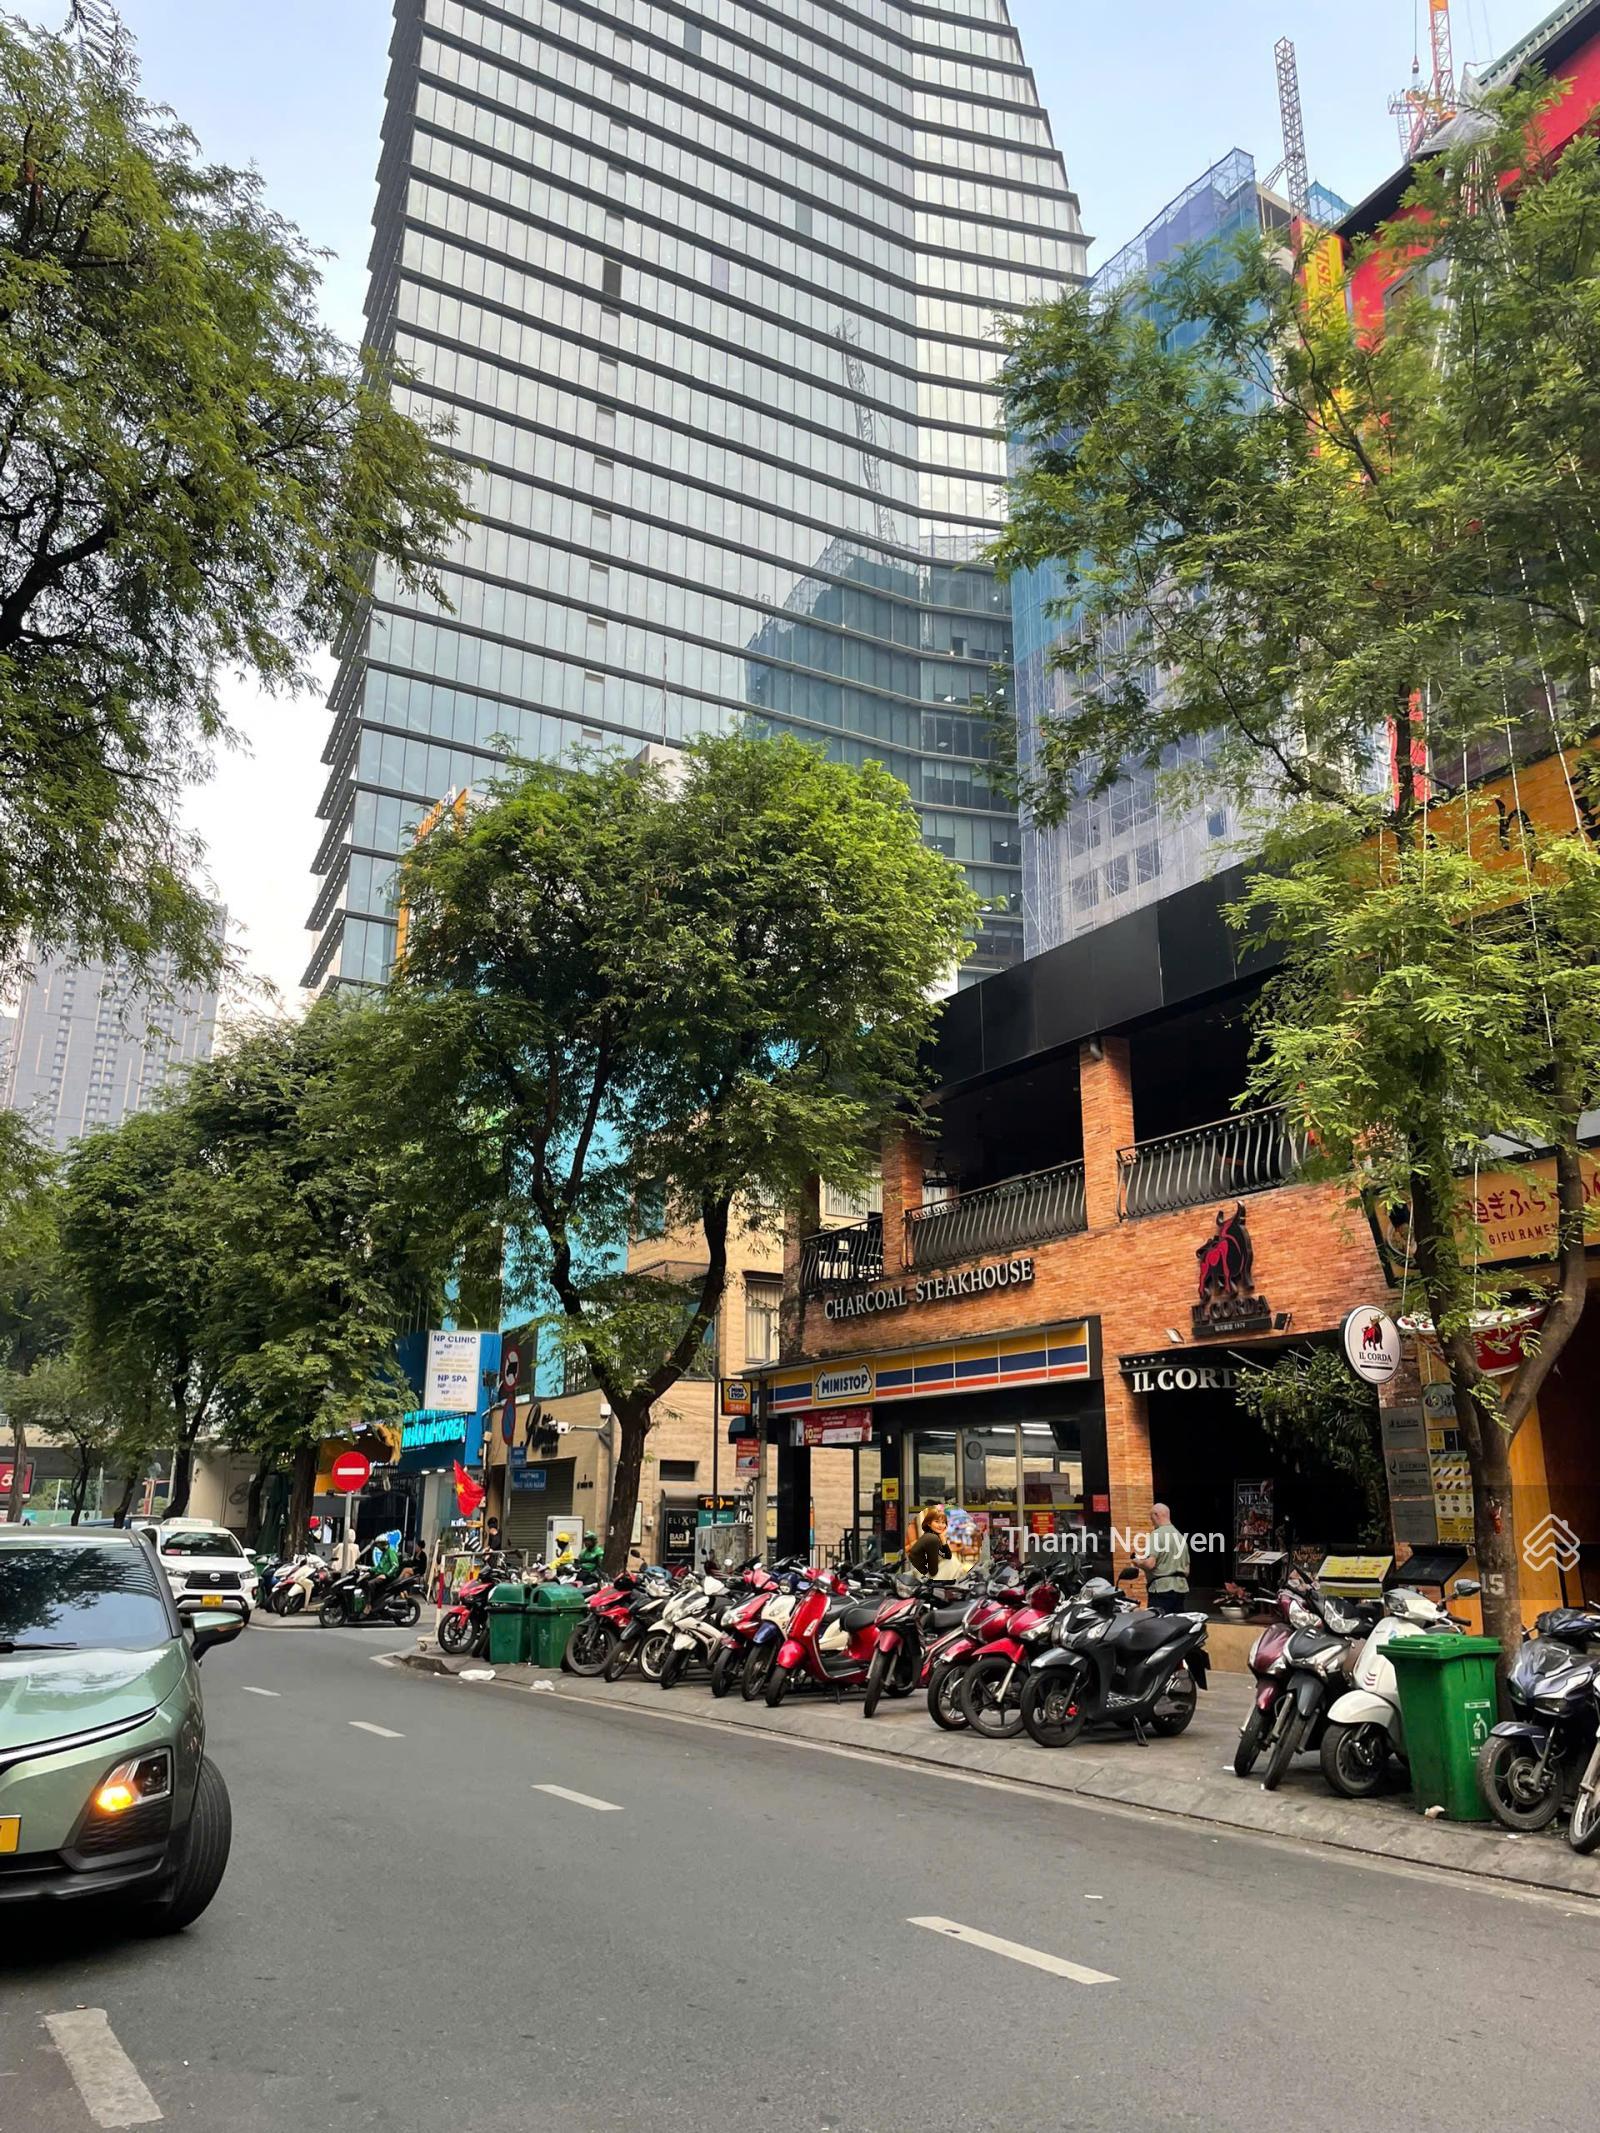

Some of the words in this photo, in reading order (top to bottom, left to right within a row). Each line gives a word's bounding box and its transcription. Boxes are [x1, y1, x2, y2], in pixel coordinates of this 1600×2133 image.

[1488, 1231, 1515, 1245] GIFU
[1519, 1222, 1558, 1239] RAMEN
[824, 1287, 908, 1320] CHARCOAL
[915, 1259, 1034, 1303] STEAKHOUSE
[447, 1336, 477, 1344] CLINIC
[1359, 1352, 1366, 1360] IL
[1367, 1352, 1392, 1362] CORDA
[437, 1374, 449, 1382] NP
[451, 1375, 468, 1383] SPA
[821, 1374, 868, 1394] MINISTOP
[1132, 1371, 1155, 1392] IL
[1157, 1368, 1241, 1391] CORD
[668, 1516, 697, 1526] ELIXIR
[734, 1510, 753, 1523] Ma
[669, 1533, 685, 1541] BAR
